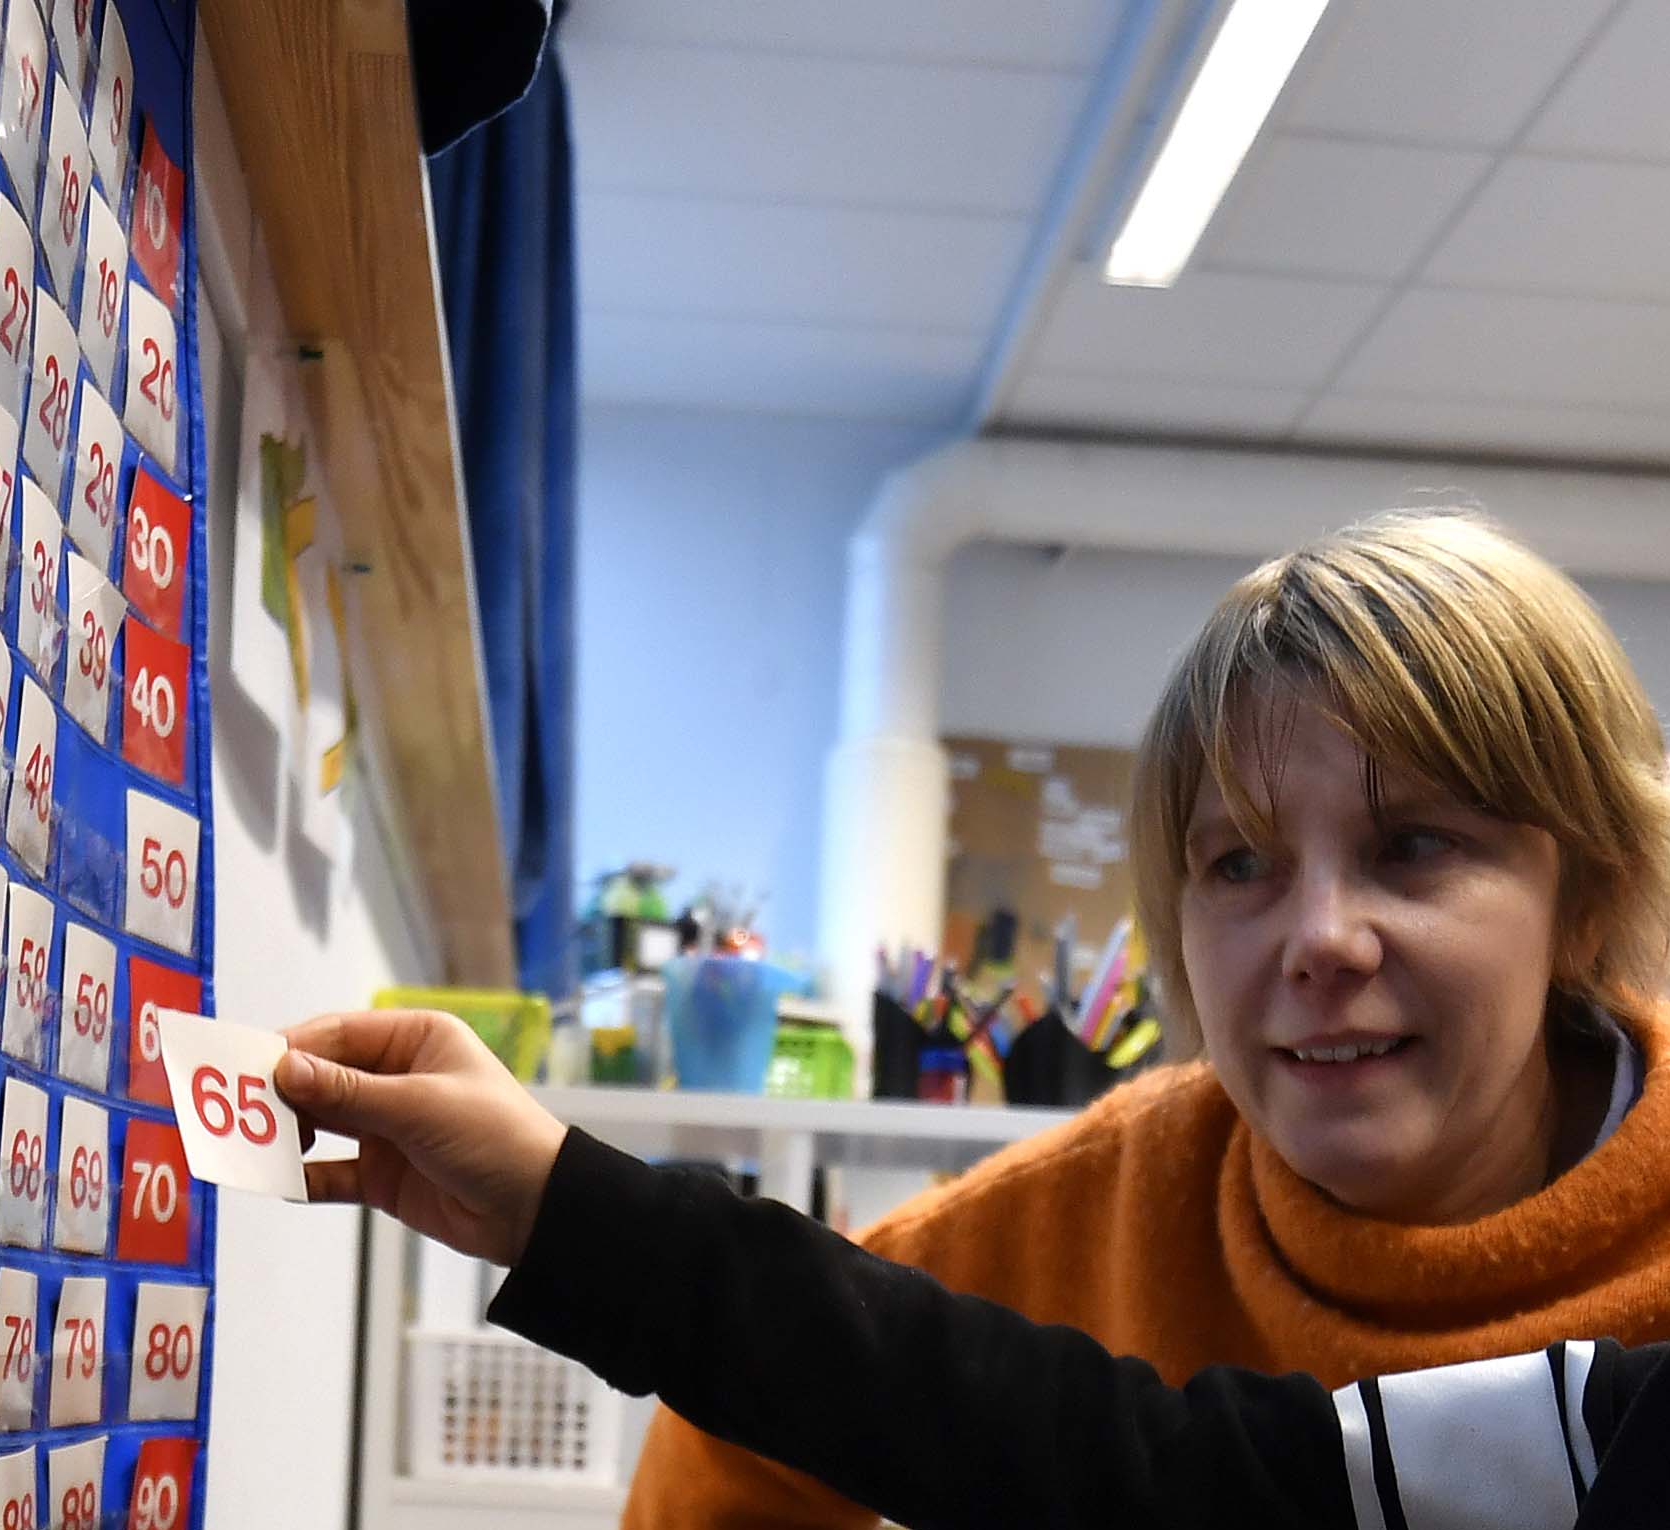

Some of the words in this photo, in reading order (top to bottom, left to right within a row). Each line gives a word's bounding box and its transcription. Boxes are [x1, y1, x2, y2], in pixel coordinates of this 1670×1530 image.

[60, 154, 79, 246] 18
[143, 171, 167, 250] 10
[98, 258, 117, 338] 19
[39, 355, 69, 451] 28
[140, 338, 172, 421] 20
[85, 442, 114, 527] 29
[131, 506, 174, 589] 30
[80, 610, 106, 690] 39
[131, 667, 175, 738] 40
[25, 743, 51, 823] 48
[139, 838, 188, 908] 50
[74, 973, 108, 1044] 59
[139, 1000, 160, 1062] 6
[191, 1065, 277, 1144] 65
[10, 1129, 41, 1201] 68
[70, 1146, 103, 1212] 69
[132, 1162, 177, 1223] 70
[3, 1315, 32, 1383] 78
[64, 1318, 96, 1380] 79
[145, 1323, 194, 1380] 80
